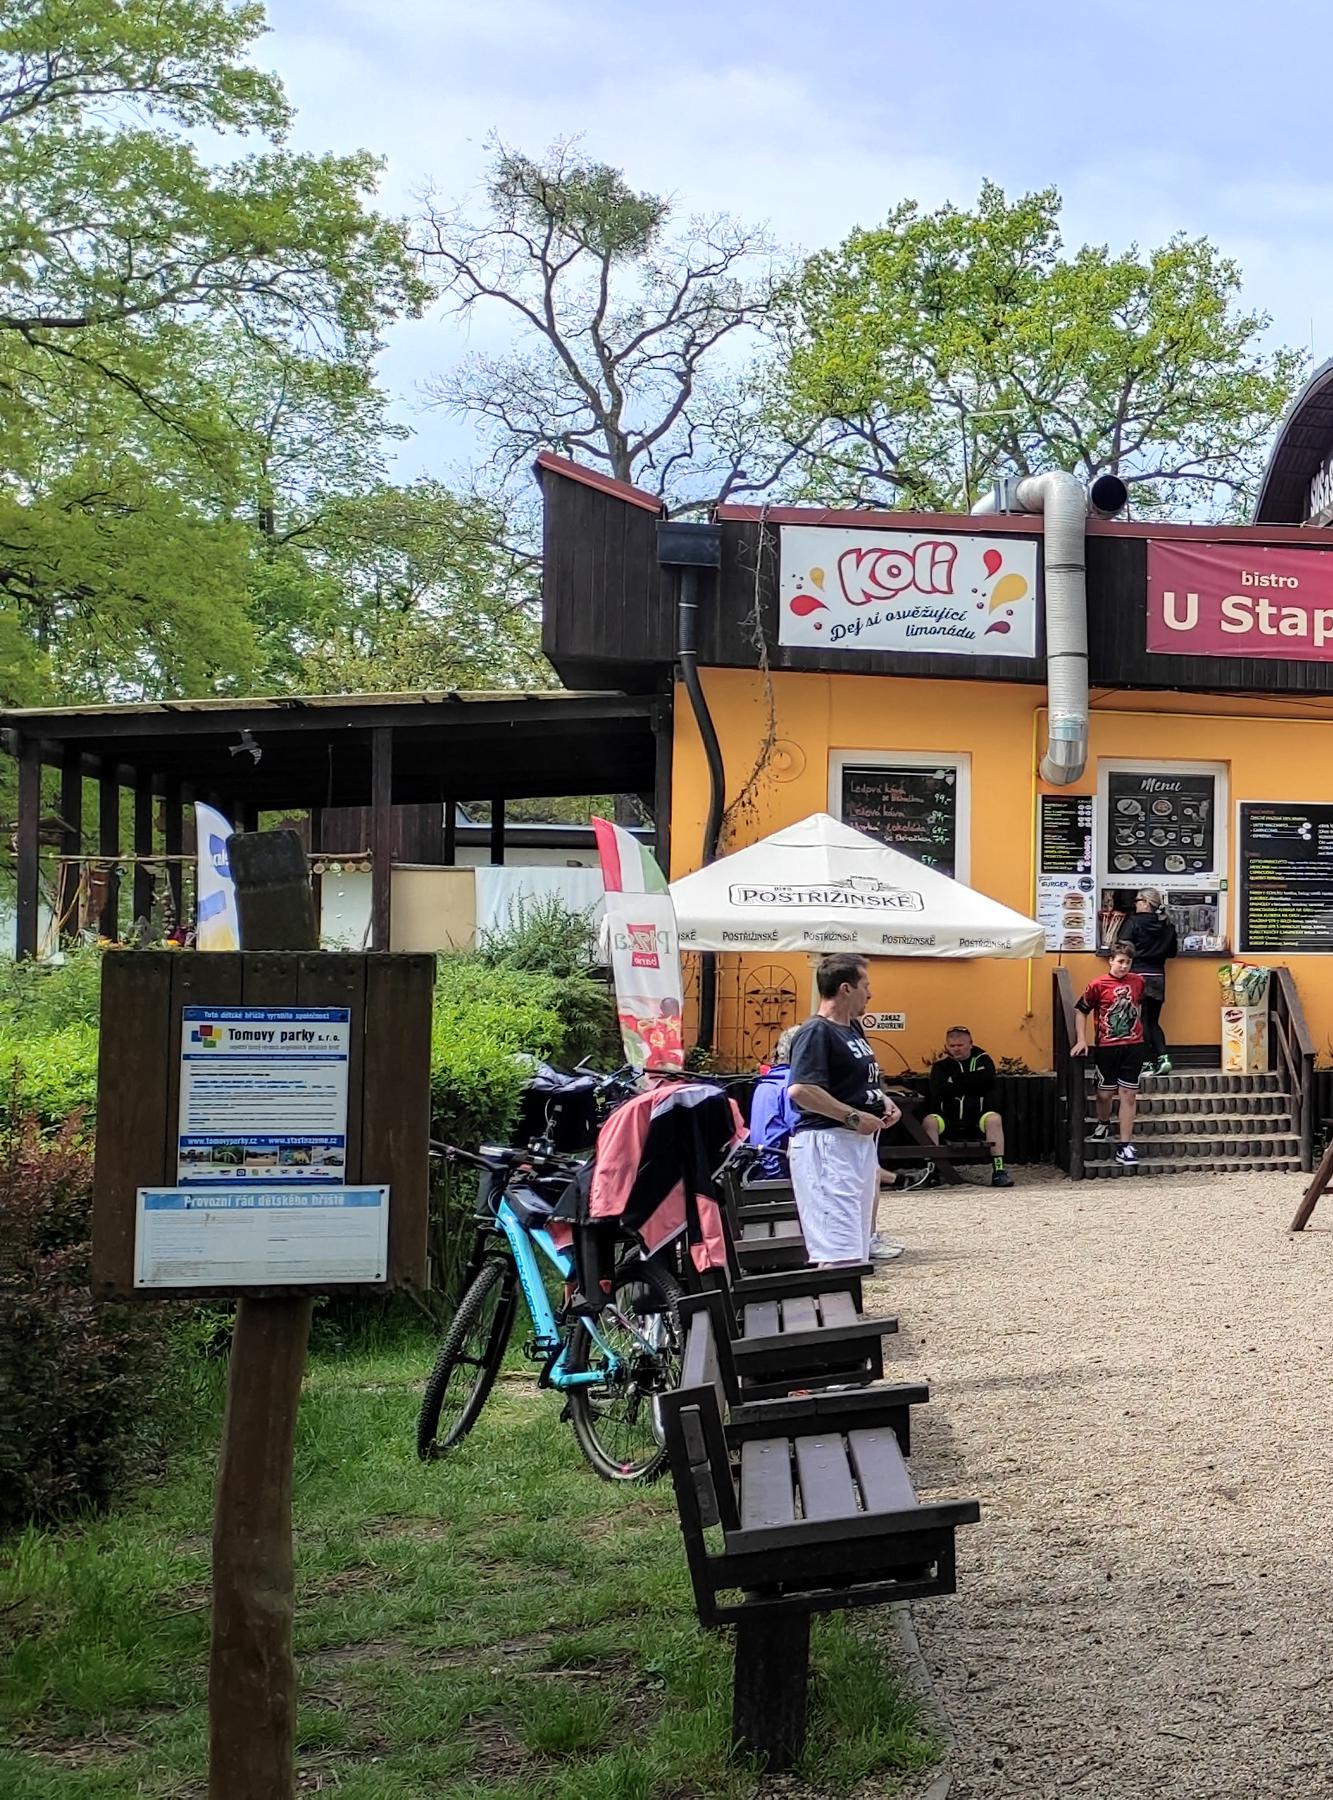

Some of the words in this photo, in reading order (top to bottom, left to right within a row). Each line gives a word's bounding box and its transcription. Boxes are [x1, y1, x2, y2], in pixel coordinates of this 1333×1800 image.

[1241, 571, 1299, 589] bistro
[1163, 591, 1199, 631] U
[830, 618, 864, 641] Dej
[866, 612, 881, 628] si
[886, 606, 969, 622] osvěžující
[906, 625, 976, 640] limonádu
[1140, 778, 1182, 792] Menu
[228, 1028, 275, 1042] Tomovy
[281, 1029, 315, 1043] parky
[184, 1194, 231, 1208] Provozní
[235, 1194, 255, 1206] řád
[258, 1193, 307, 1206] dětského
[312, 1193, 345, 1205] hřiště
